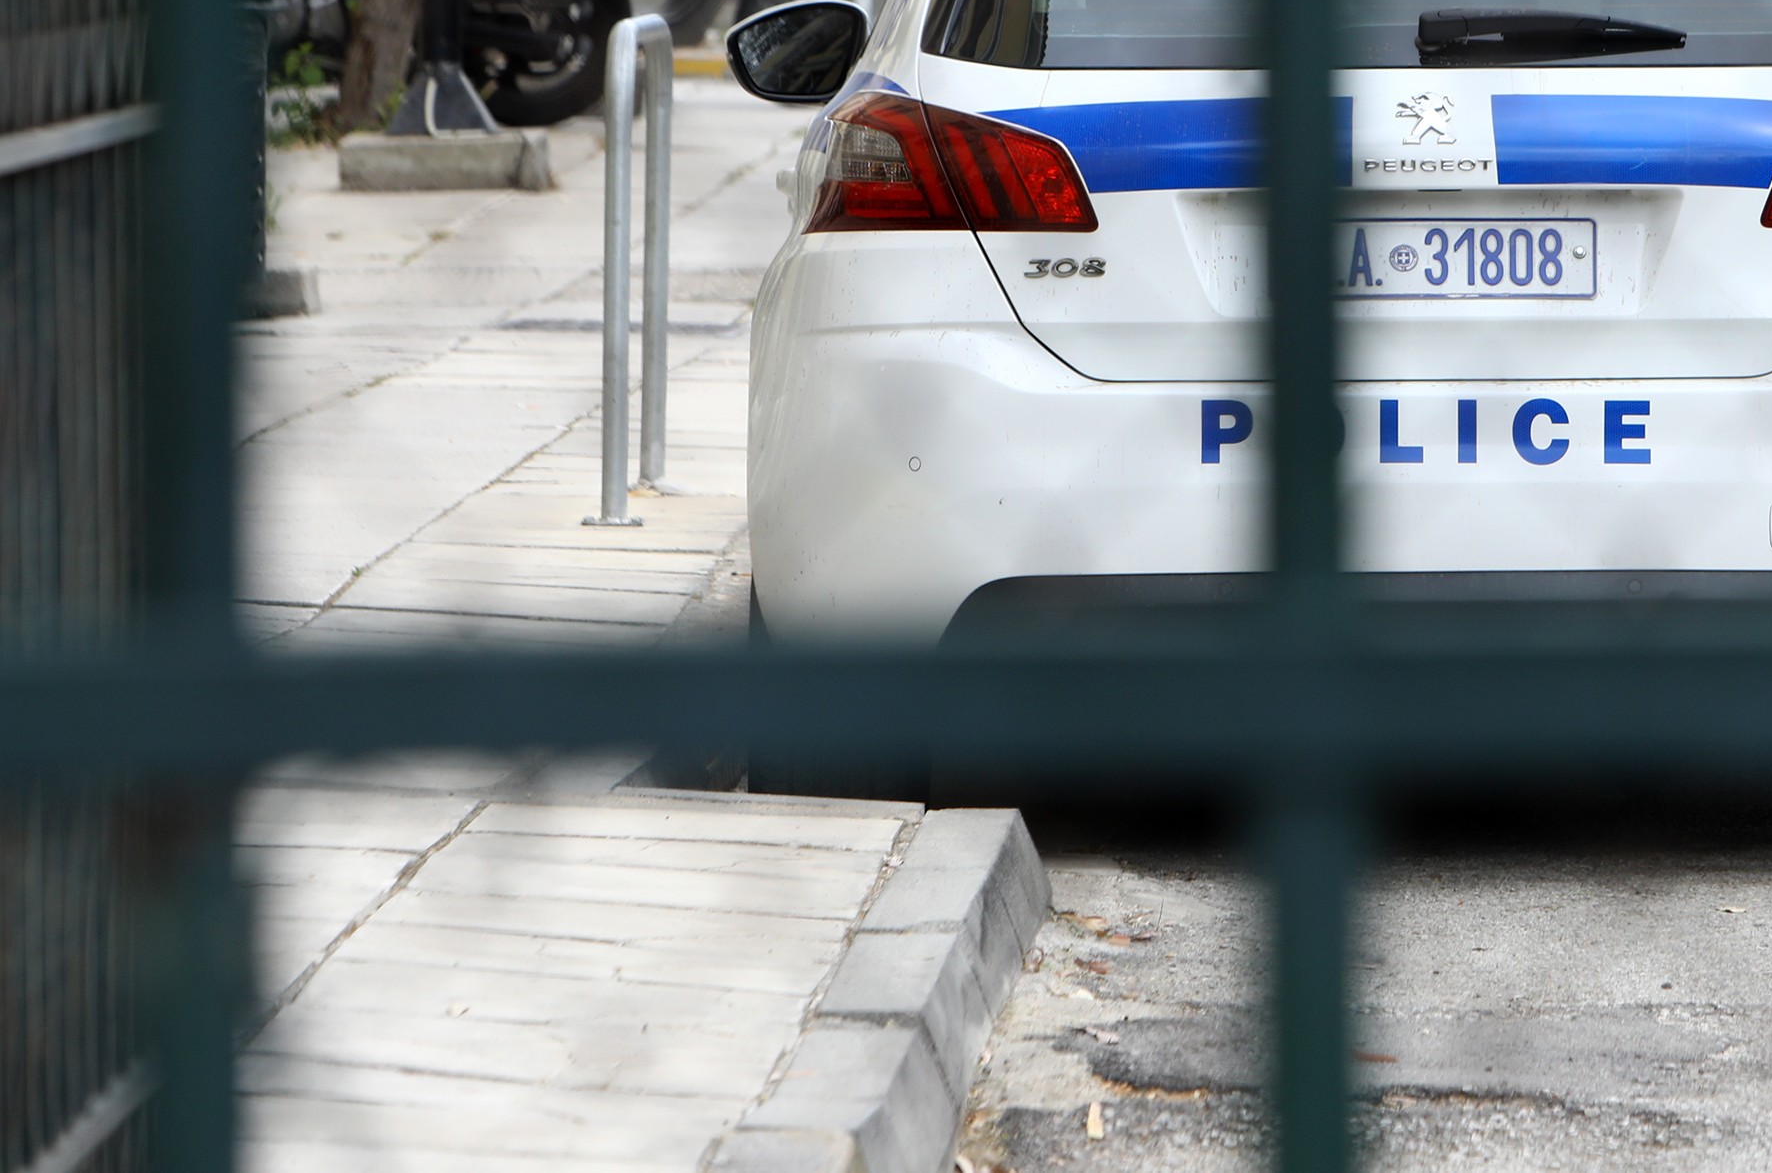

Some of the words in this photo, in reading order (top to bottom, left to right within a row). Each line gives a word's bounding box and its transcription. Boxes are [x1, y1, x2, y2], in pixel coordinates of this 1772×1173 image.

[1364, 158, 1494, 173] PEUGEOT
[1023, 257, 1107, 278] 308
[1424, 228, 1563, 287] 31808
[1201, 398, 1652, 465] PLICE
